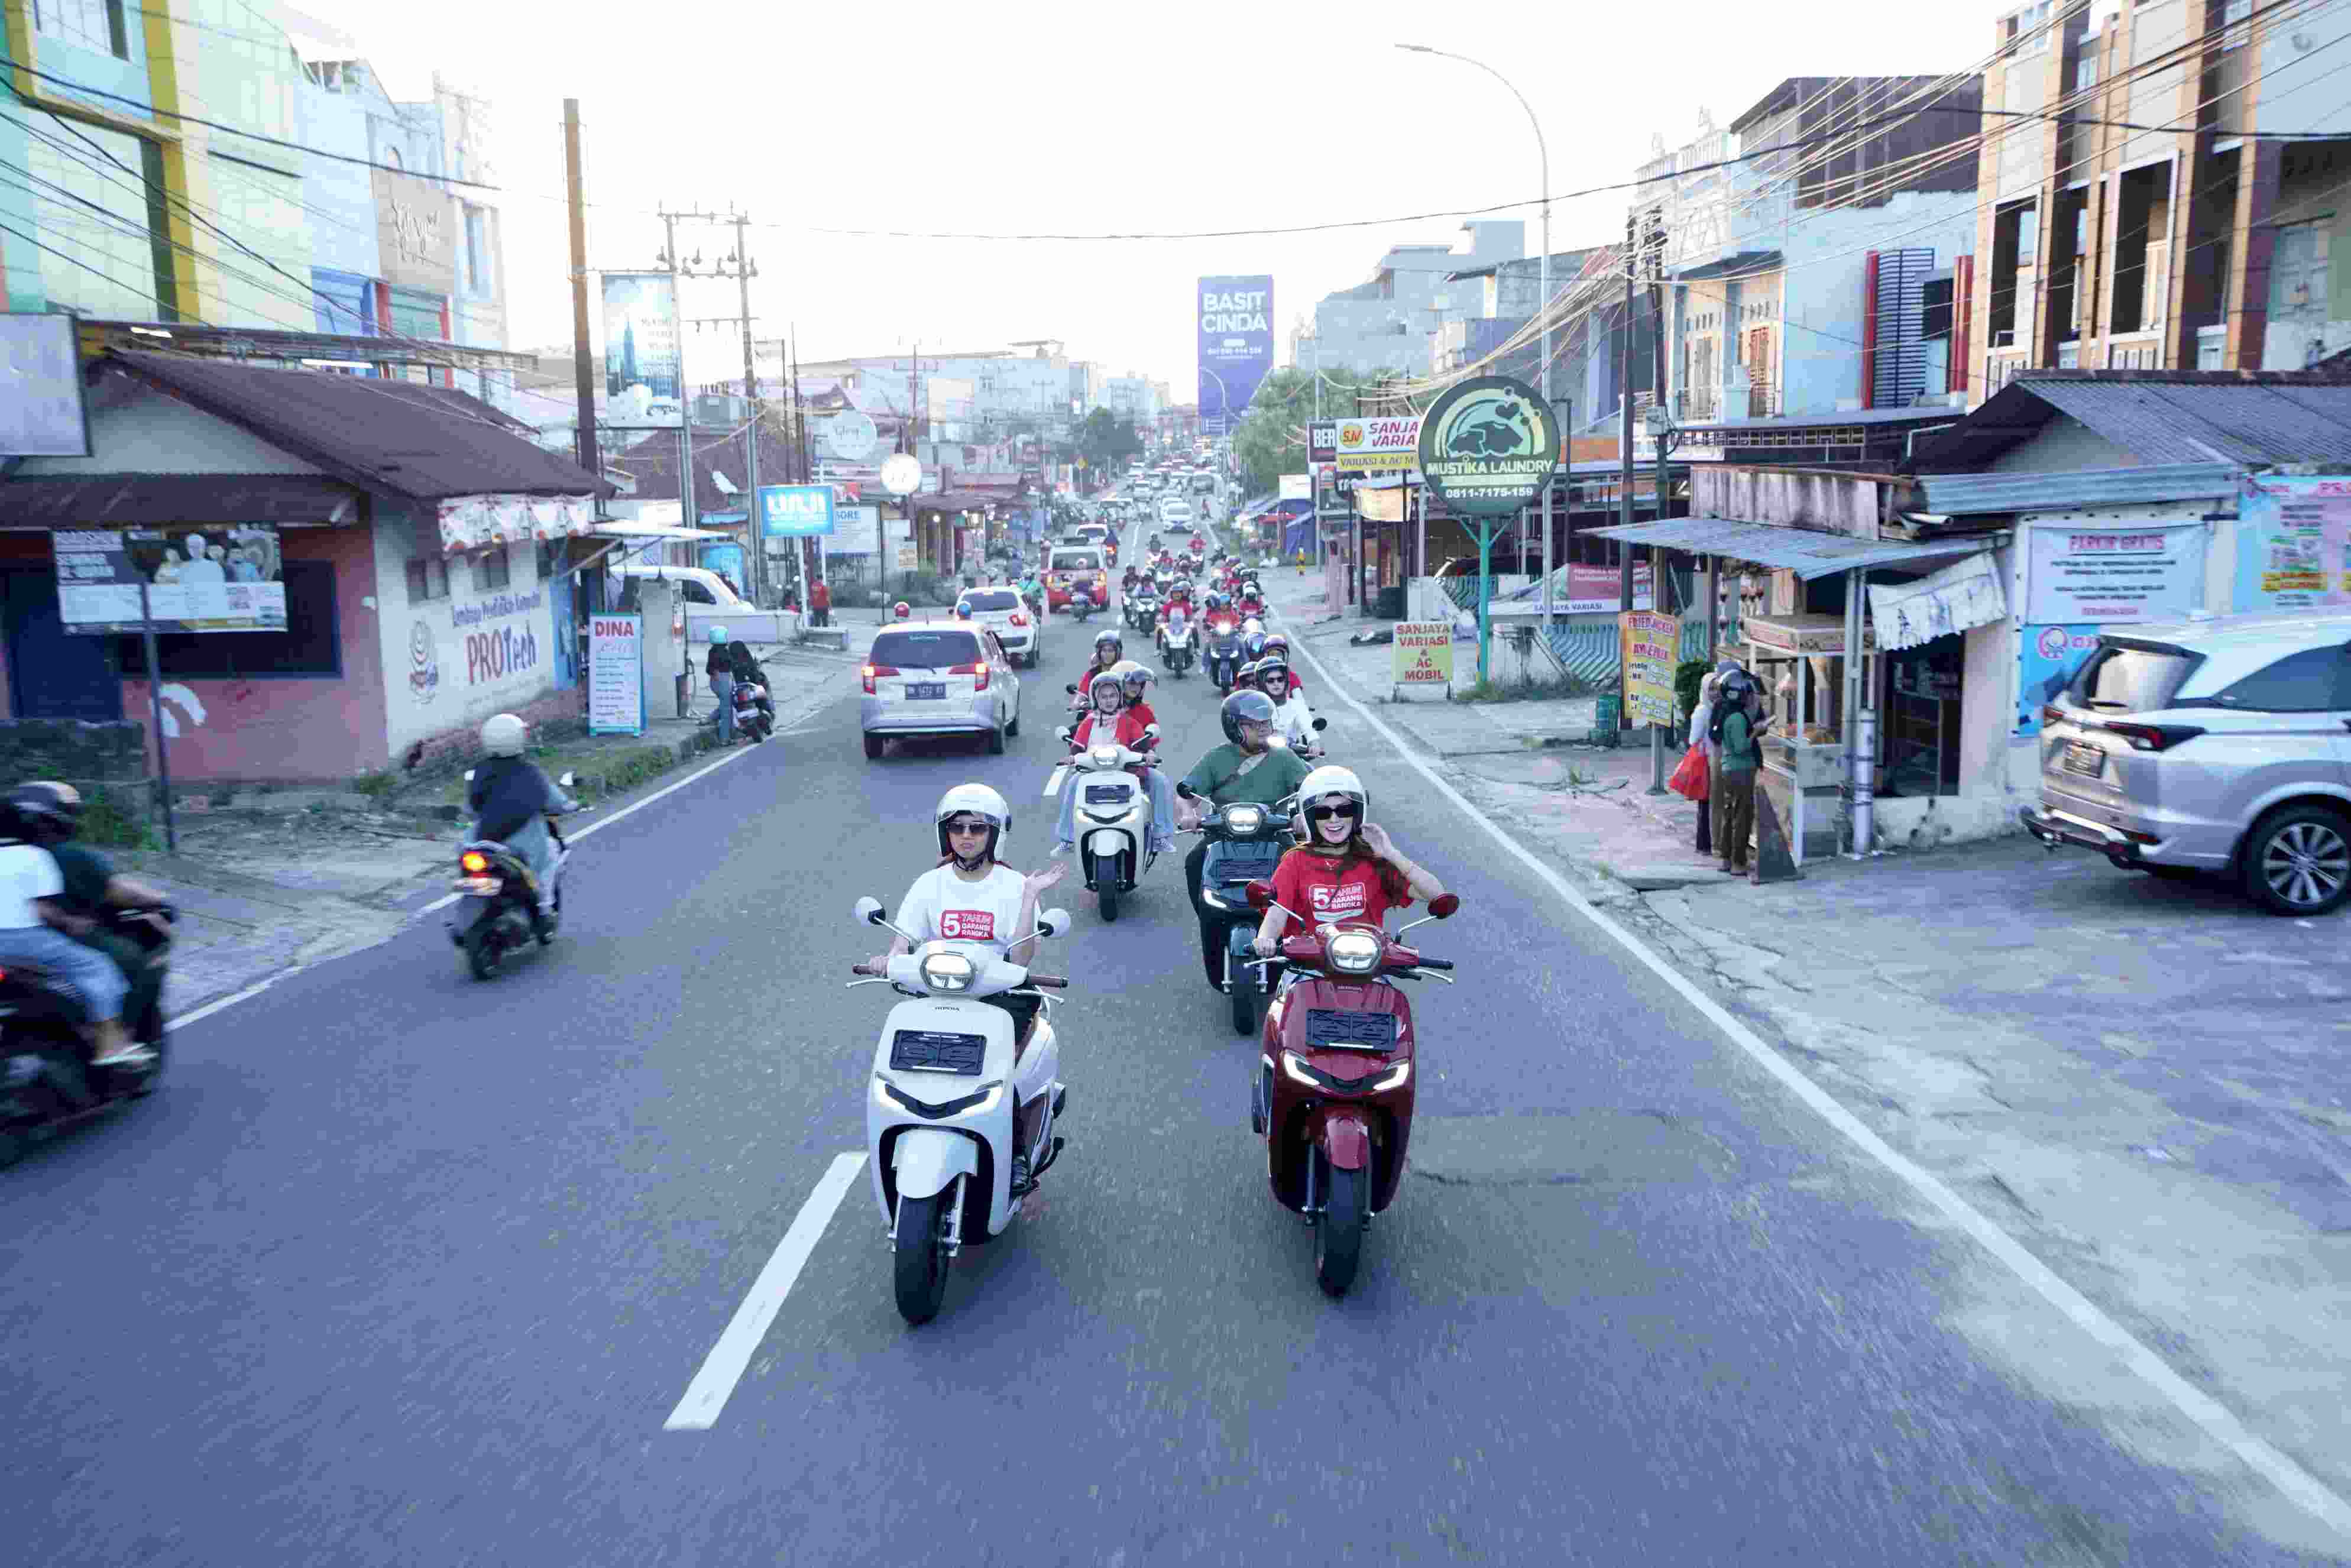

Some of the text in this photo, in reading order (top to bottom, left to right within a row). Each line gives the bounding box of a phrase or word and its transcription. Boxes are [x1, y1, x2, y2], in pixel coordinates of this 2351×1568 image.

[1203, 291, 1267, 312] BASIT
[1202, 313, 1268, 333] CINDA
[1490, 459, 1553, 474] LAUNDRY
[595, 621, 634, 637] DINA
[1395, 624, 1450, 634] SANJAYA
[1399, 635, 1448, 647] VARIASI
[1416, 657, 1433, 668] AC
[1404, 669, 1444, 681] MOBIL
[1314, 888, 1330, 909] 5
[943, 913, 961, 937] 5
